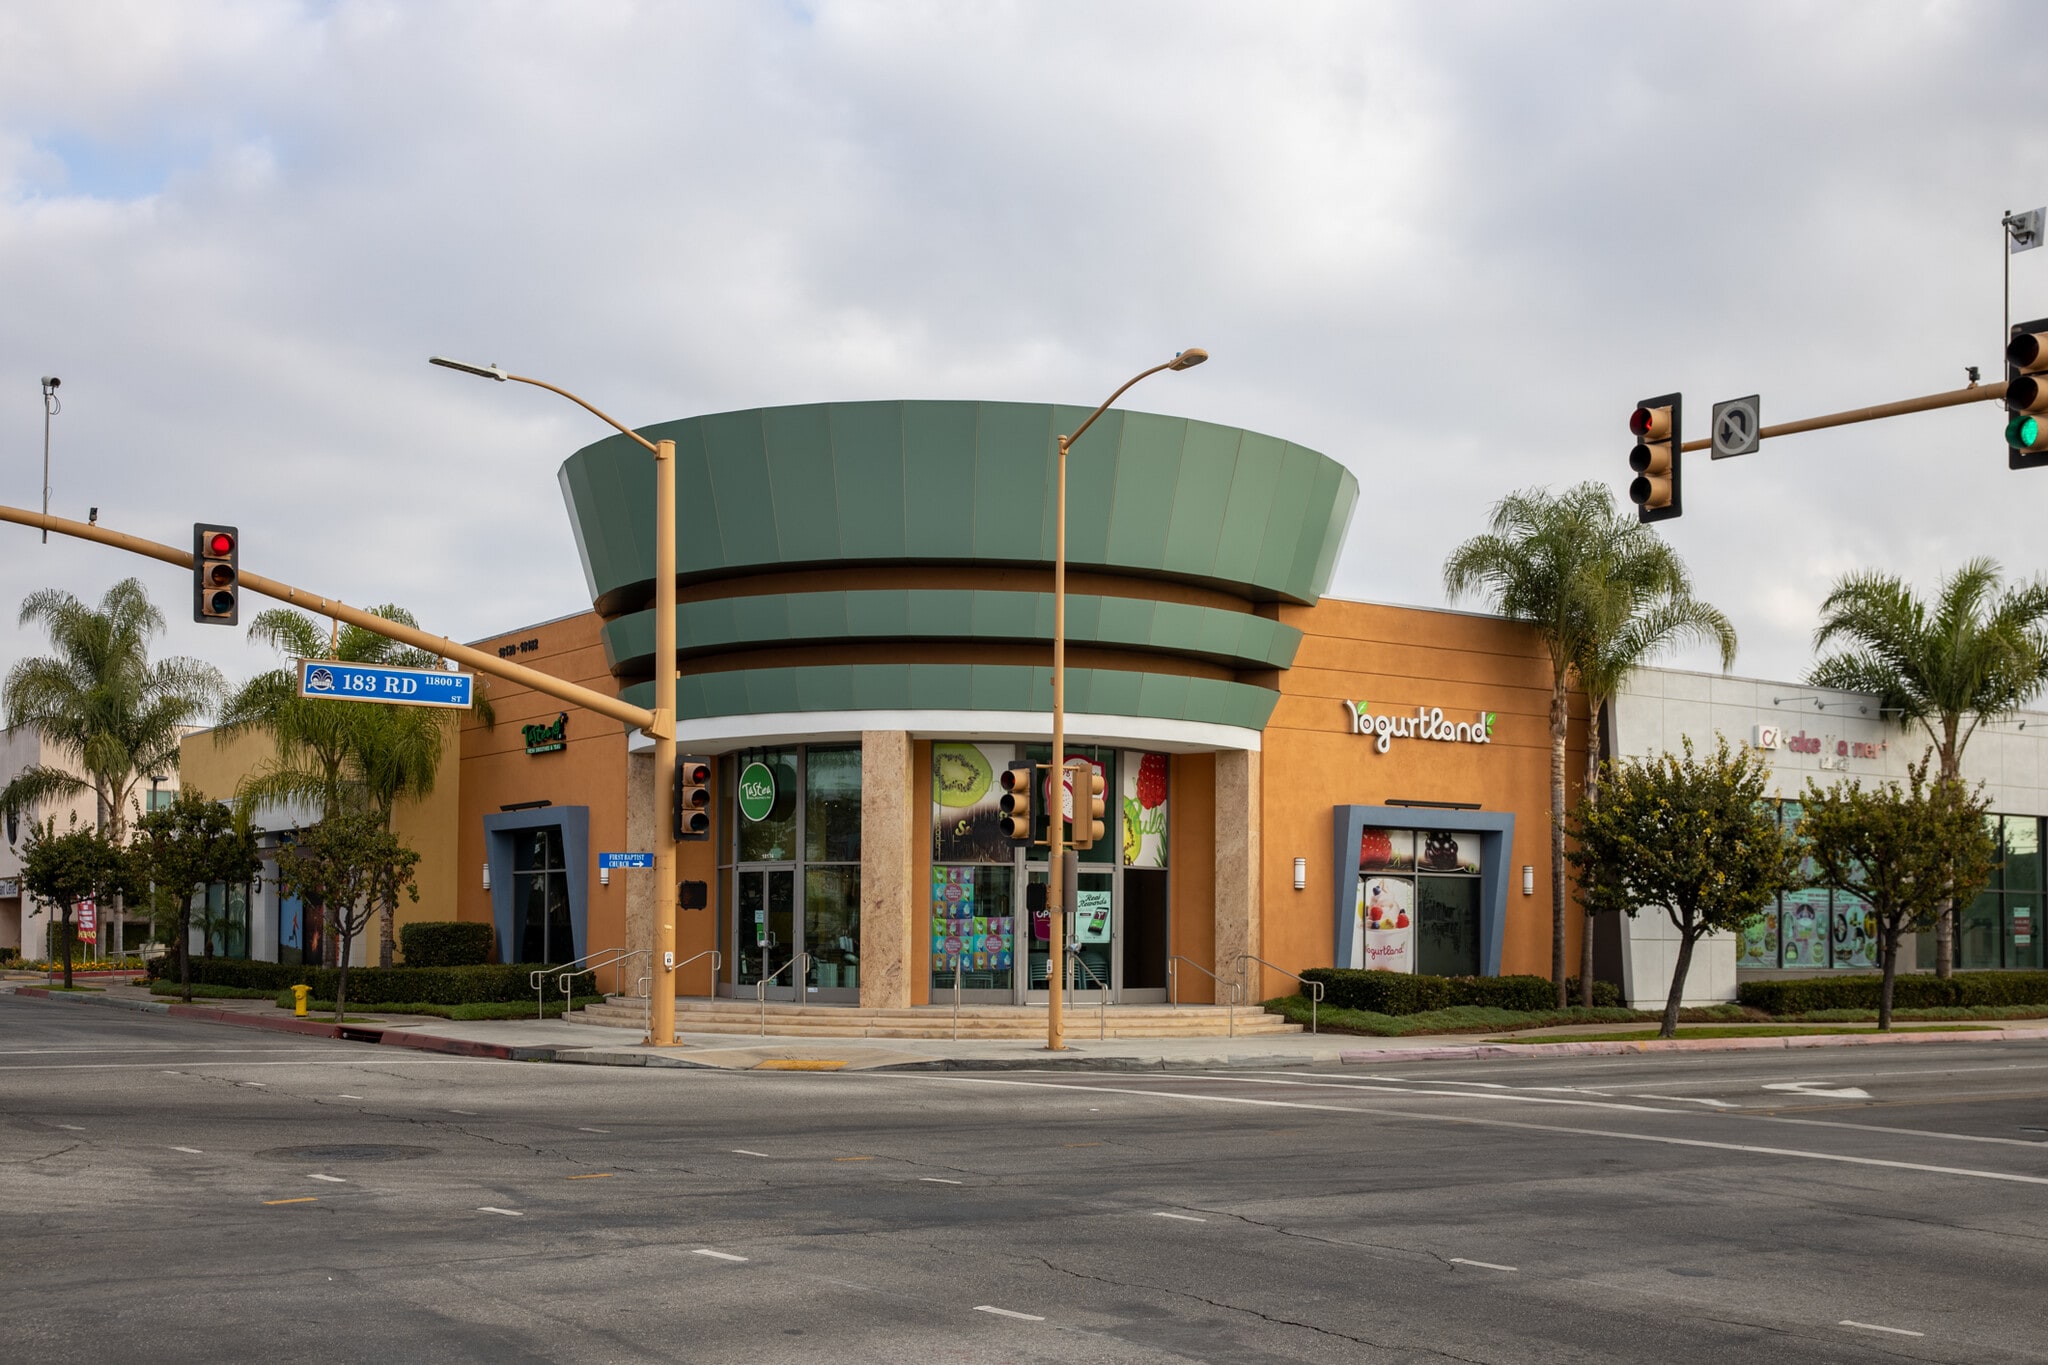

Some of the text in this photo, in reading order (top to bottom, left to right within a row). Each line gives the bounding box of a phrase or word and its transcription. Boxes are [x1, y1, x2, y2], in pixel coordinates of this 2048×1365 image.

[342, 674, 376, 692] 183
[384, 676, 417, 694] RD
[425, 676, 462, 687] 11800 E
[451, 695, 462, 703] ST
[1343, 699, 1491, 754] Yogurtland
[1085, 893, 1101, 901] Real
[1078, 898, 1107, 907] Rewards
